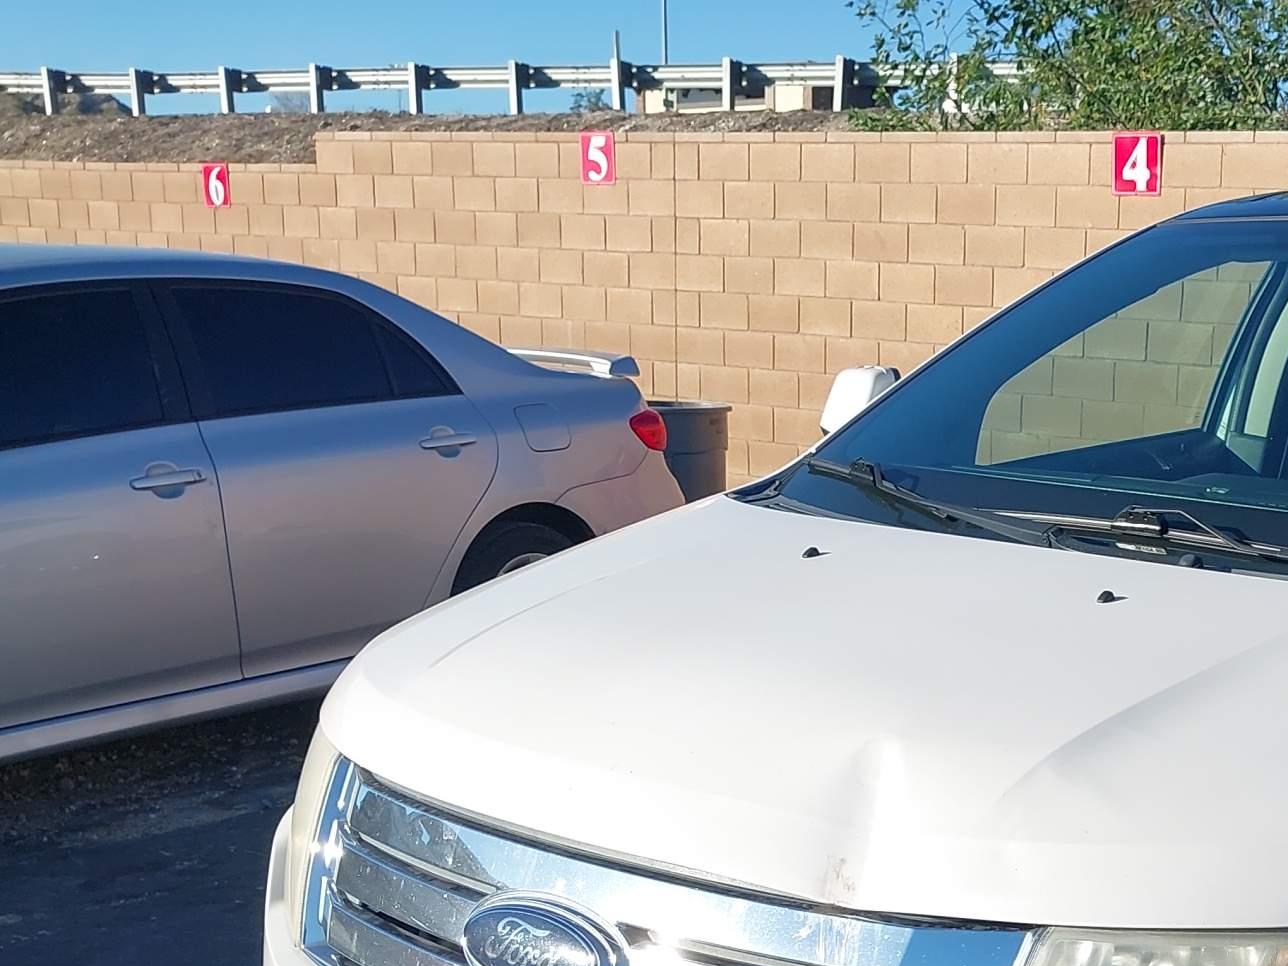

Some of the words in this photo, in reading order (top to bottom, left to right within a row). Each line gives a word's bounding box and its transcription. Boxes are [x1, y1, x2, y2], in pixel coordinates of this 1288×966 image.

[587, 135, 608, 182] 5
[1122, 136, 1151, 192] 4
[208, 166, 225, 206] 6
